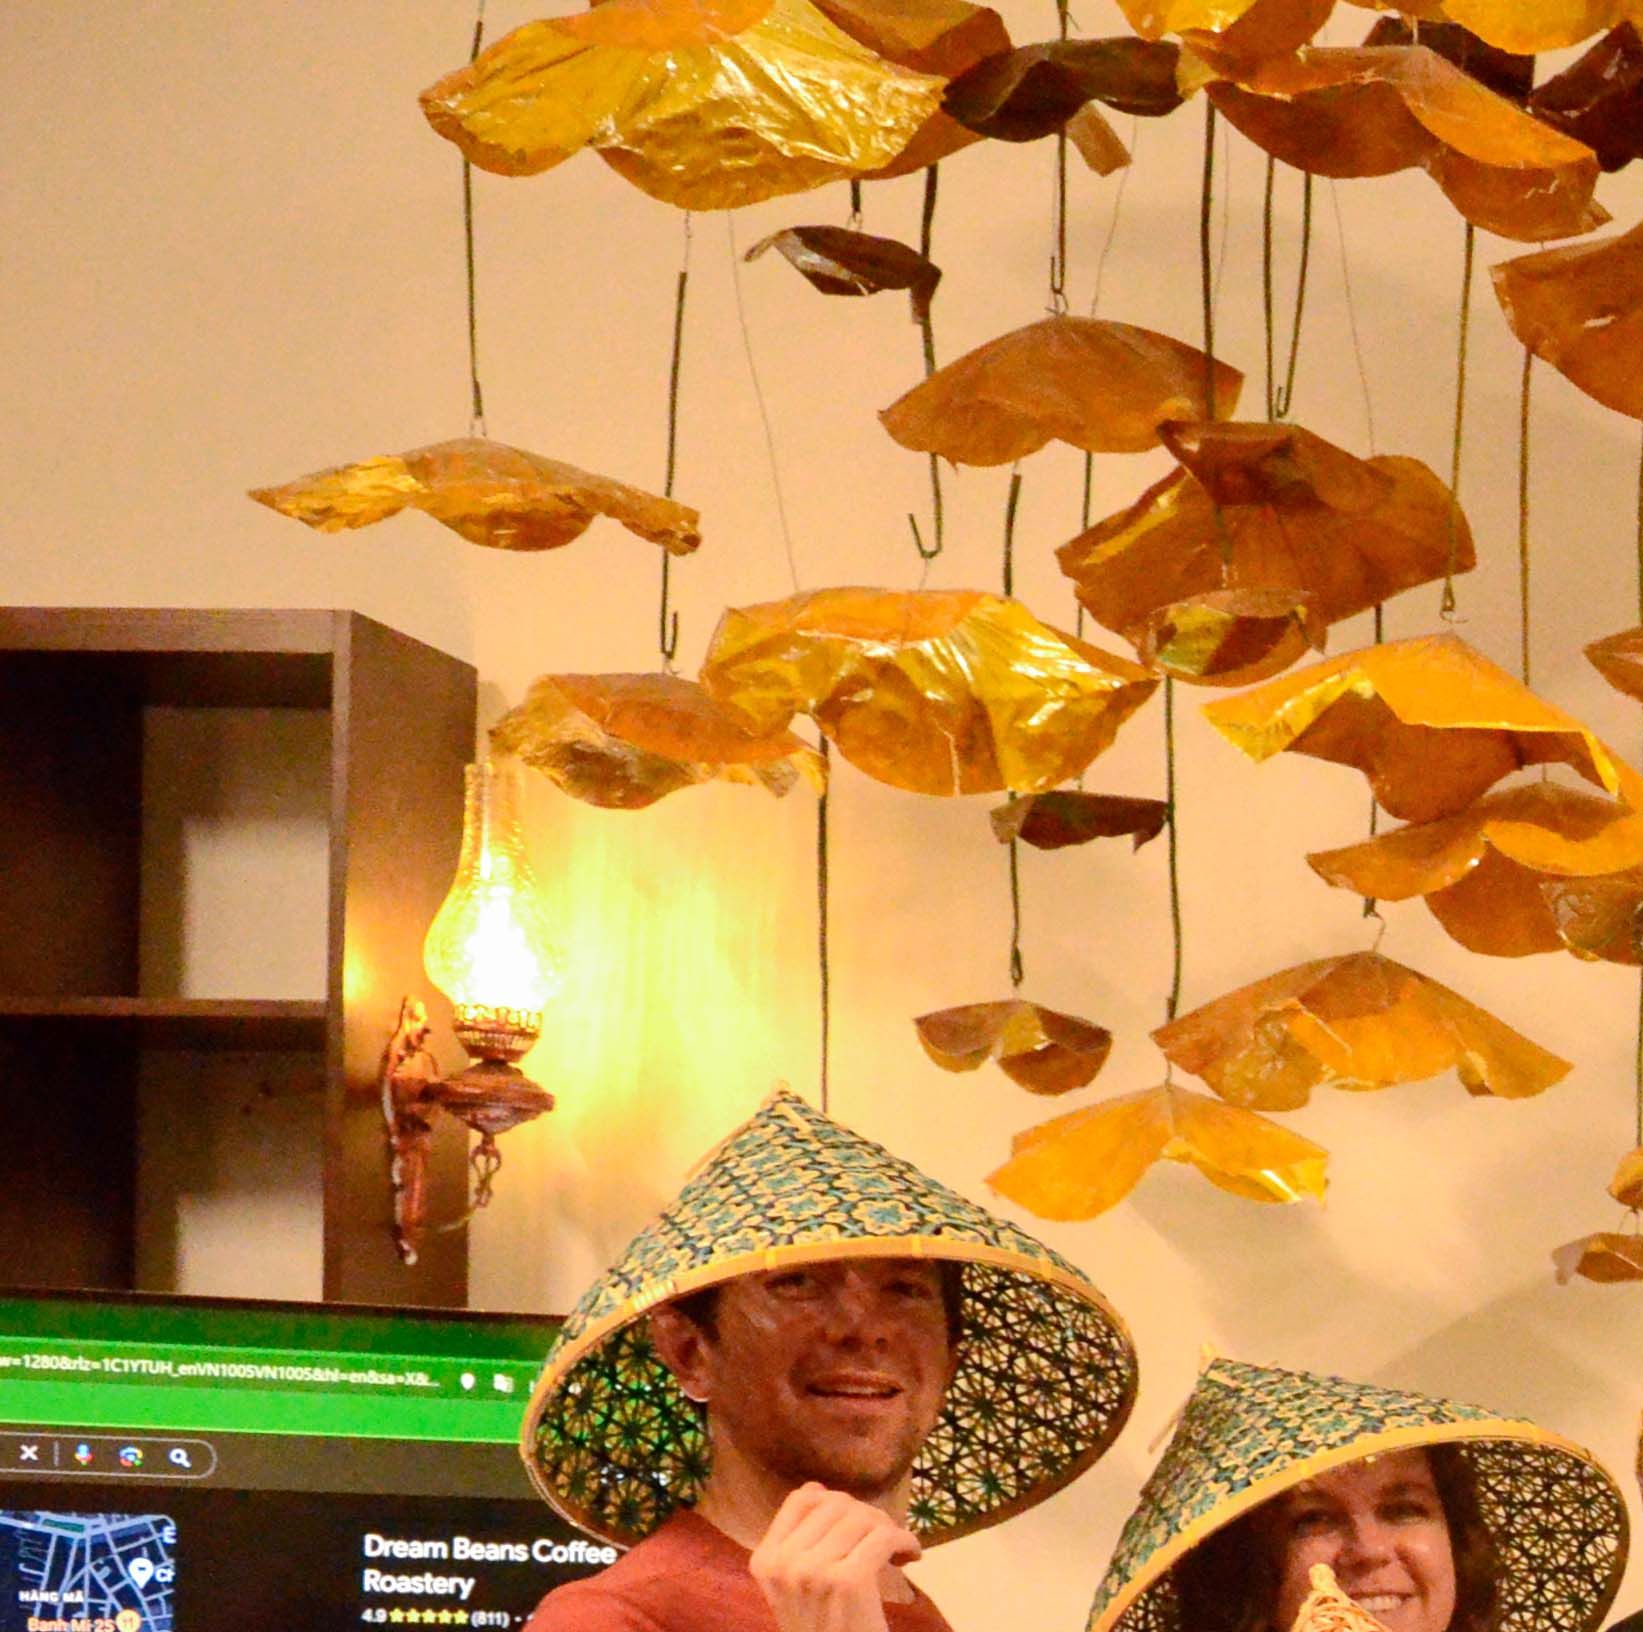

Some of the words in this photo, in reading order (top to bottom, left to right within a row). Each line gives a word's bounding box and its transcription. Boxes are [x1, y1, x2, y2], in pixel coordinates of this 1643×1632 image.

[364, 1533, 448, 1560] Dream
[452, 1536, 529, 1562] Beans
[532, 1538, 618, 1564] Coffee
[363, 1568, 476, 1600] Roastery
[361, 1608, 388, 1623] 4.9
[471, 1610, 511, 1629] (811)
